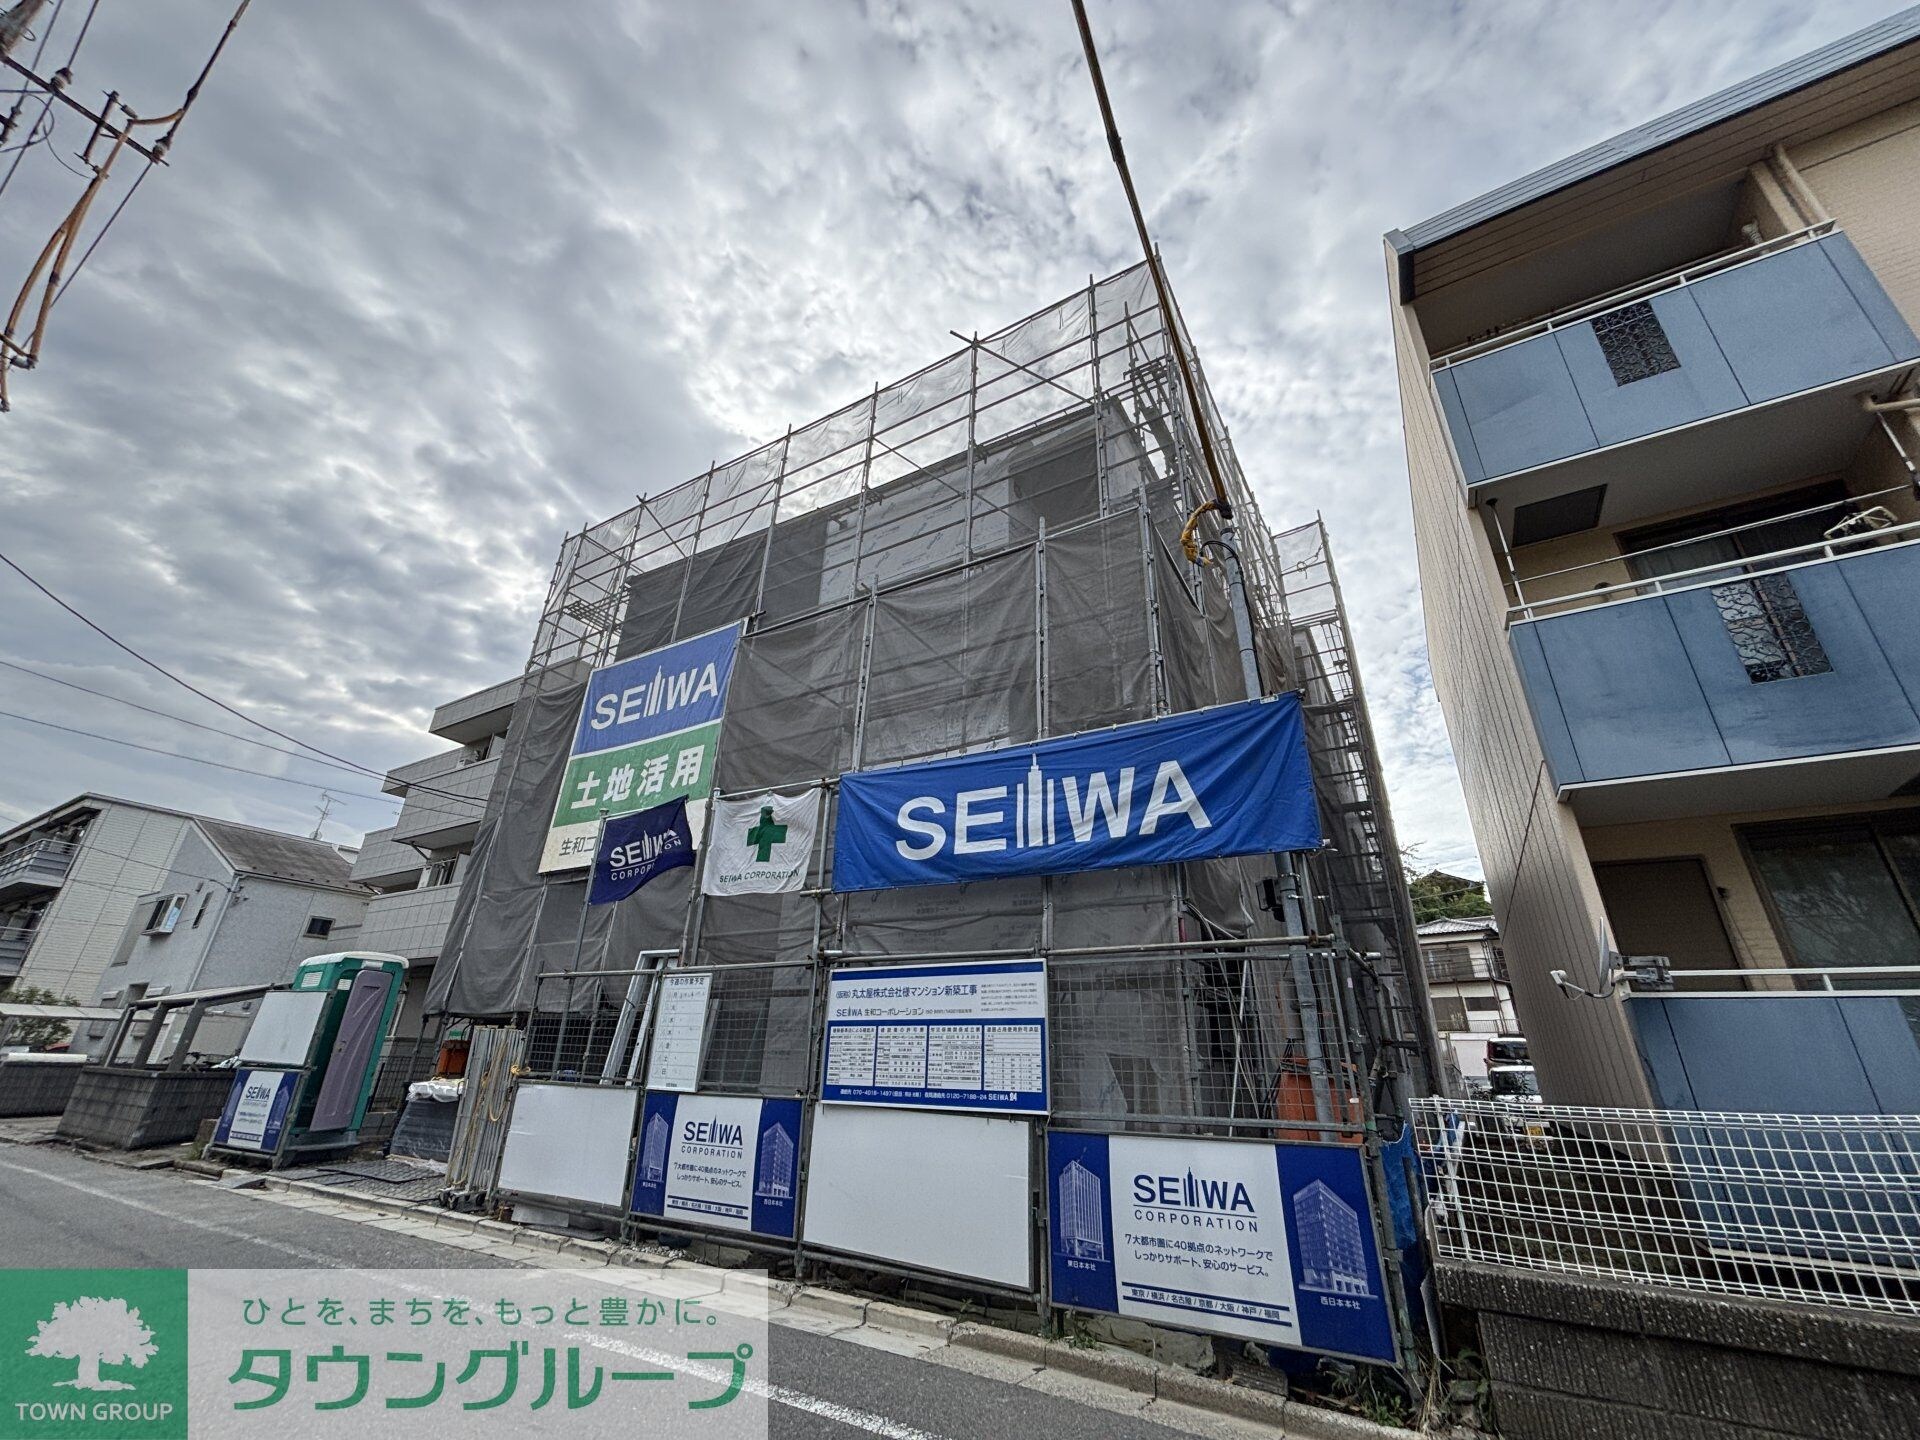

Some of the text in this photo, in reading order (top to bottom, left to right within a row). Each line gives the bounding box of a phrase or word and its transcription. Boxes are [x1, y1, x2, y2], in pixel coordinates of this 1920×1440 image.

[591, 663, 719, 730] SEIWA
[570, 744, 706, 810] 土地活用
[895, 753, 1213, 861] SEIWA
[720, 868, 799, 883] SEIWA CORPORATION
[836, 1006, 863, 1017] SEIWA
[864, 1007, 924, 1017] 生和コーポレーション
[245, 1083, 271, 1100] SEIWA
[683, 1115, 743, 1146] SEIWA
[681, 1145, 743, 1159] CORPORATION
[1133, 1166, 1255, 1213] SEIWA
[1134, 1209, 1258, 1233] CORPORATION
[1124, 1233, 1273, 1262] 7大都市圏に40拠点のネットワークで
[1134, 1251, 1269, 1278] しっかりサポート、安心のサービス。
[1320, 1297, 1361, 1310] 西日本本社
